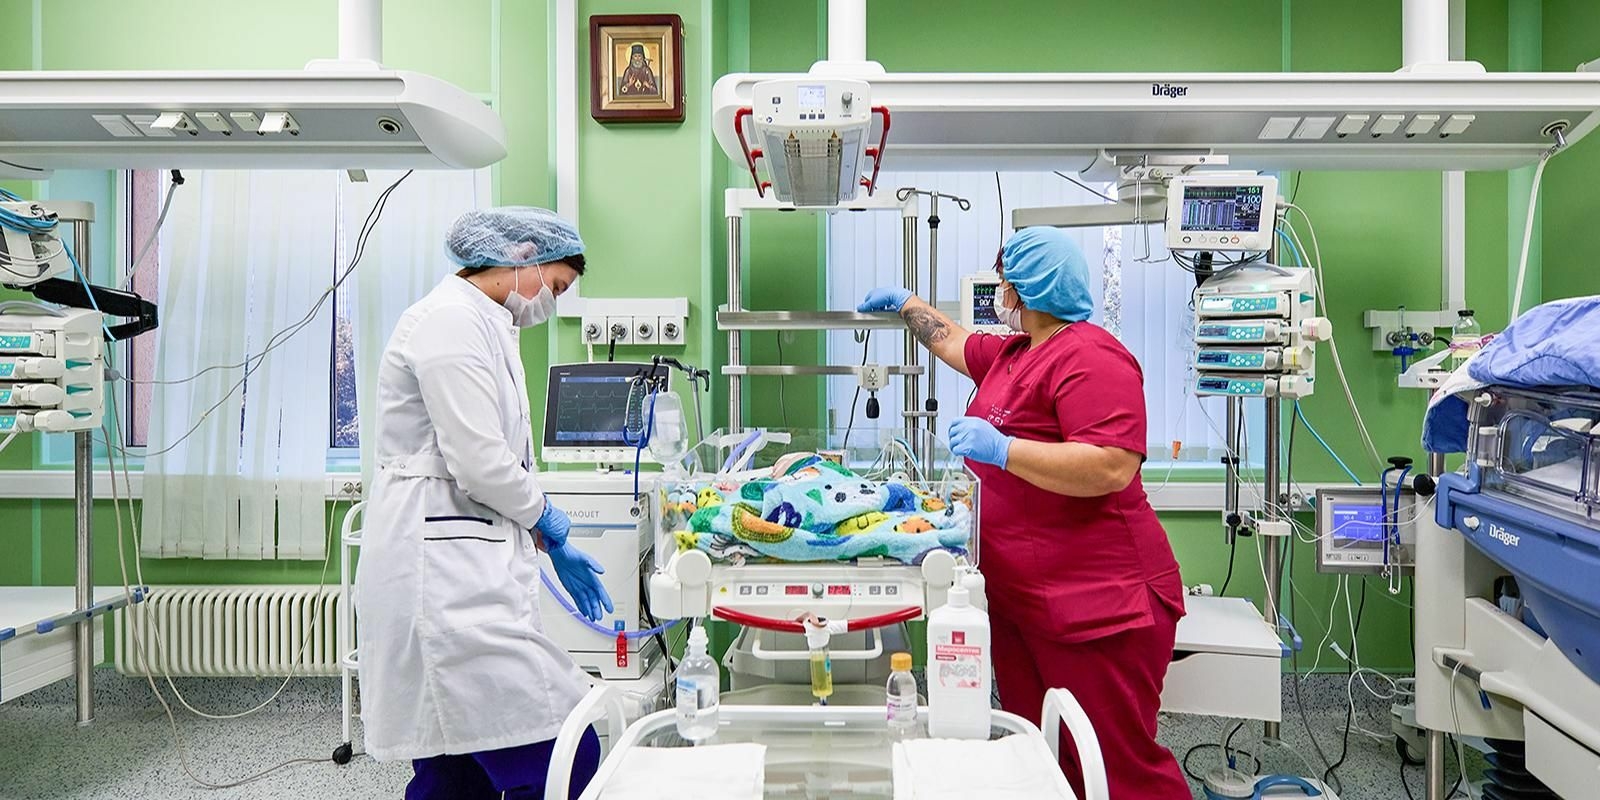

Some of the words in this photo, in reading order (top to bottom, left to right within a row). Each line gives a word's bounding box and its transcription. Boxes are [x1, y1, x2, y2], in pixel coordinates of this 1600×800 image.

[1152, 83, 1188, 98] Dräger
[566, 510, 600, 518] MAQUET
[1489, 523, 1520, 547] Dräger
